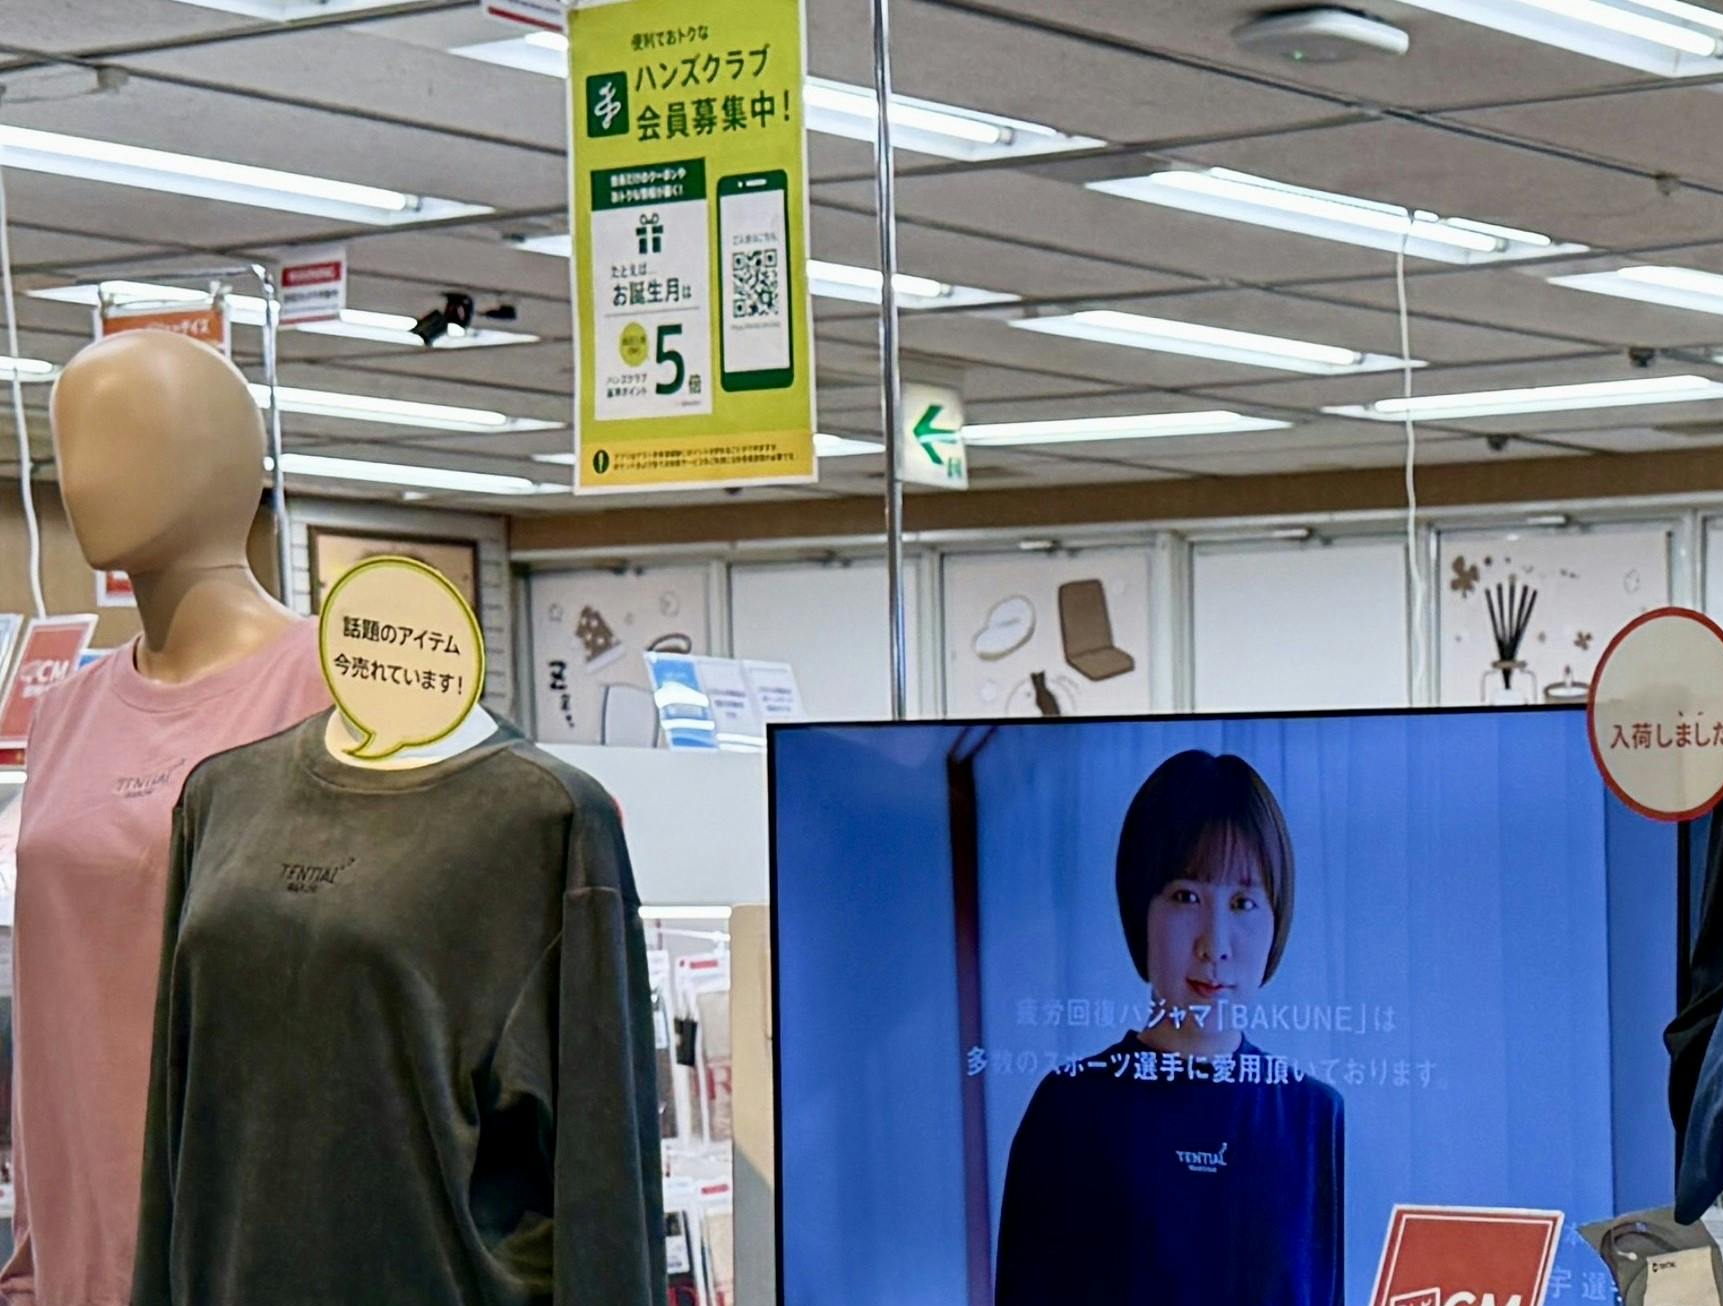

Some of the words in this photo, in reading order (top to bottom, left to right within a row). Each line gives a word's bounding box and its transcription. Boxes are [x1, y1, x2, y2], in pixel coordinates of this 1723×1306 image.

[635, 43, 771, 92] ハンズクラブ
[612, 277, 693, 307] お誕生月は
[342, 615, 461, 656] 話題のアイテム
[333, 653, 464, 696] 今売れています!
